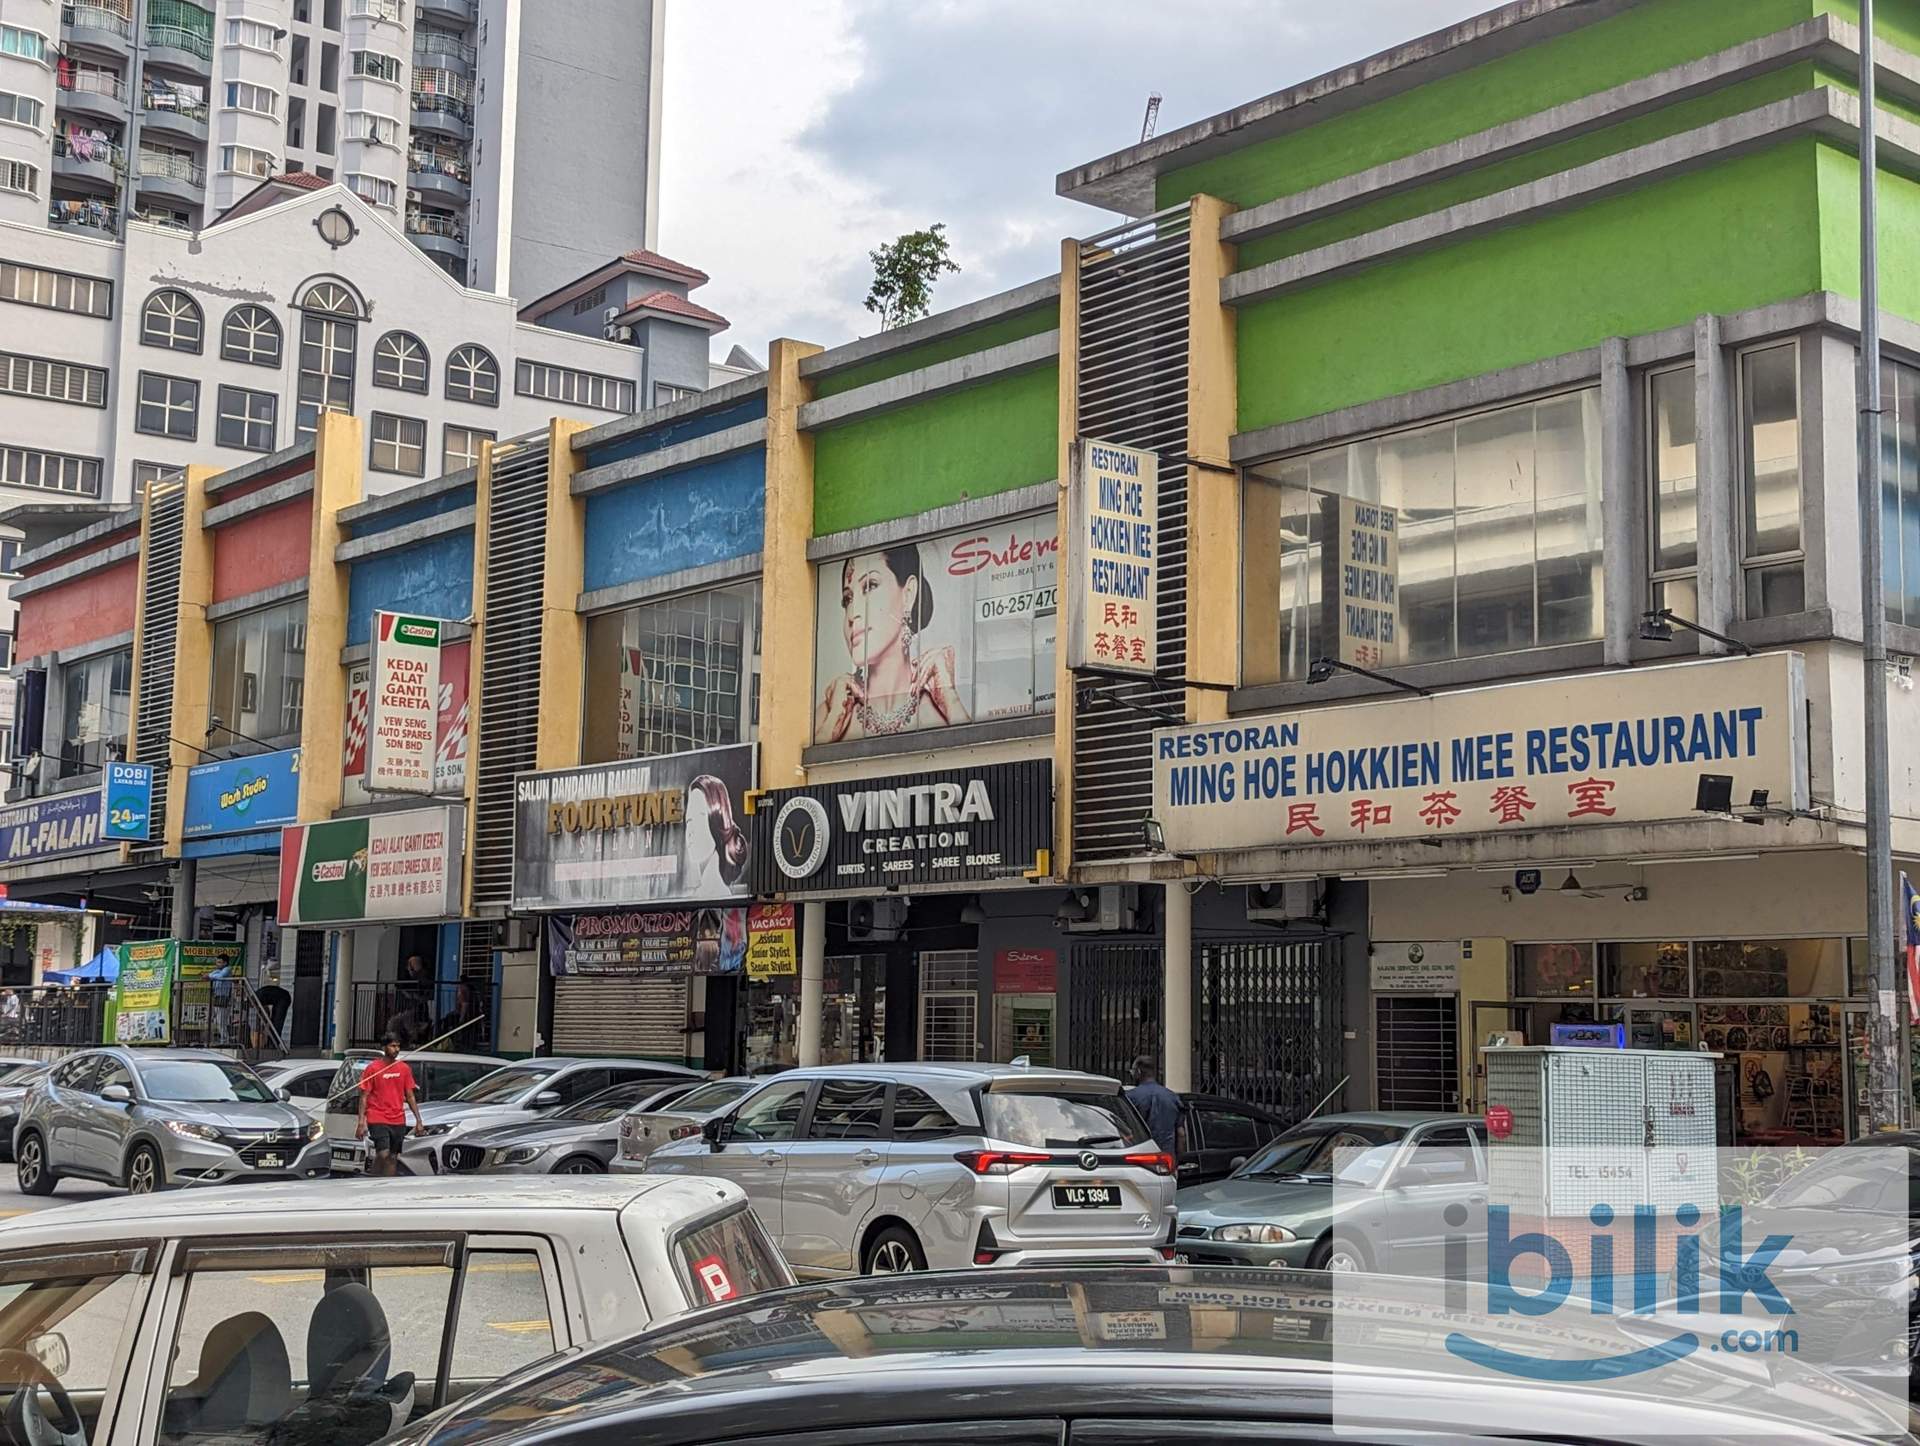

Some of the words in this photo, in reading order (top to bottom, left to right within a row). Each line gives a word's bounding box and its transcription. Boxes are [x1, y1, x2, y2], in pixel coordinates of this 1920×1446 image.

[1091, 446, 1139, 478] RESTORAN
[1099, 476, 1122, 514] MING
[1124, 483, 1142, 518] HOE
[1091, 514, 1131, 556] HOKKIEN
[1133, 523, 1152, 559] MEE
[1092, 558, 1150, 601] RESTAURANT
[982, 594, 1033, 618] 016-257
[1104, 602, 1137, 629] 民和
[408, 626, 434, 638] Castrol
[1094, 632, 1146, 664] 茶餐室
[387, 658, 428, 673] KEDAI
[390, 671, 424, 685] ALAT
[381, 695, 431, 710] KERETA
[386, 684, 427, 698] GANTI
[377, 727, 400, 738] AUTO
[402, 728, 433, 741] SPARES
[384, 716, 403, 727] YEW
[404, 718, 427, 729] SENG
[386, 739, 403, 749] SDN
[405, 740, 423, 751] BHD
[1159, 722, 1299, 760] RESTORAN
[1170, 761, 1235, 807] MING
[1243, 755, 1297, 800] HOE
[1306, 741, 1440, 795] HOKKIEN
[1452, 732, 1514, 783] MEE
[1527, 707, 1763, 776] RESTAURANT
[113, 767, 148, 780] DOBI
[220, 787, 241, 809] Wash
[242, 777, 267, 799] Studio
[518, 778, 550, 802] SALUN
[110, 808, 131, 824] 24
[546, 789, 683, 836] FOURTUNE
[837, 779, 995, 833] VINTRA
[1285, 776, 1617, 837] 民和茶餐室
[8, 813, 99, 858] AL-FALAH
[862, 831, 969, 854] CREATION
[320, 862, 345, 879] Castrol
[837, 863, 866, 875] KURTIS
[882, 860, 914, 872] SAREES
[932, 856, 960, 868] SAREE
[966, 853, 1001, 866] BLOUSE
[575, 911, 692, 936] PROMOTION
[1066, 1188, 1085, 1203] VLC
[1087, 1188, 1109, 1203] 1394
[699, 1263, 731, 1302] P
